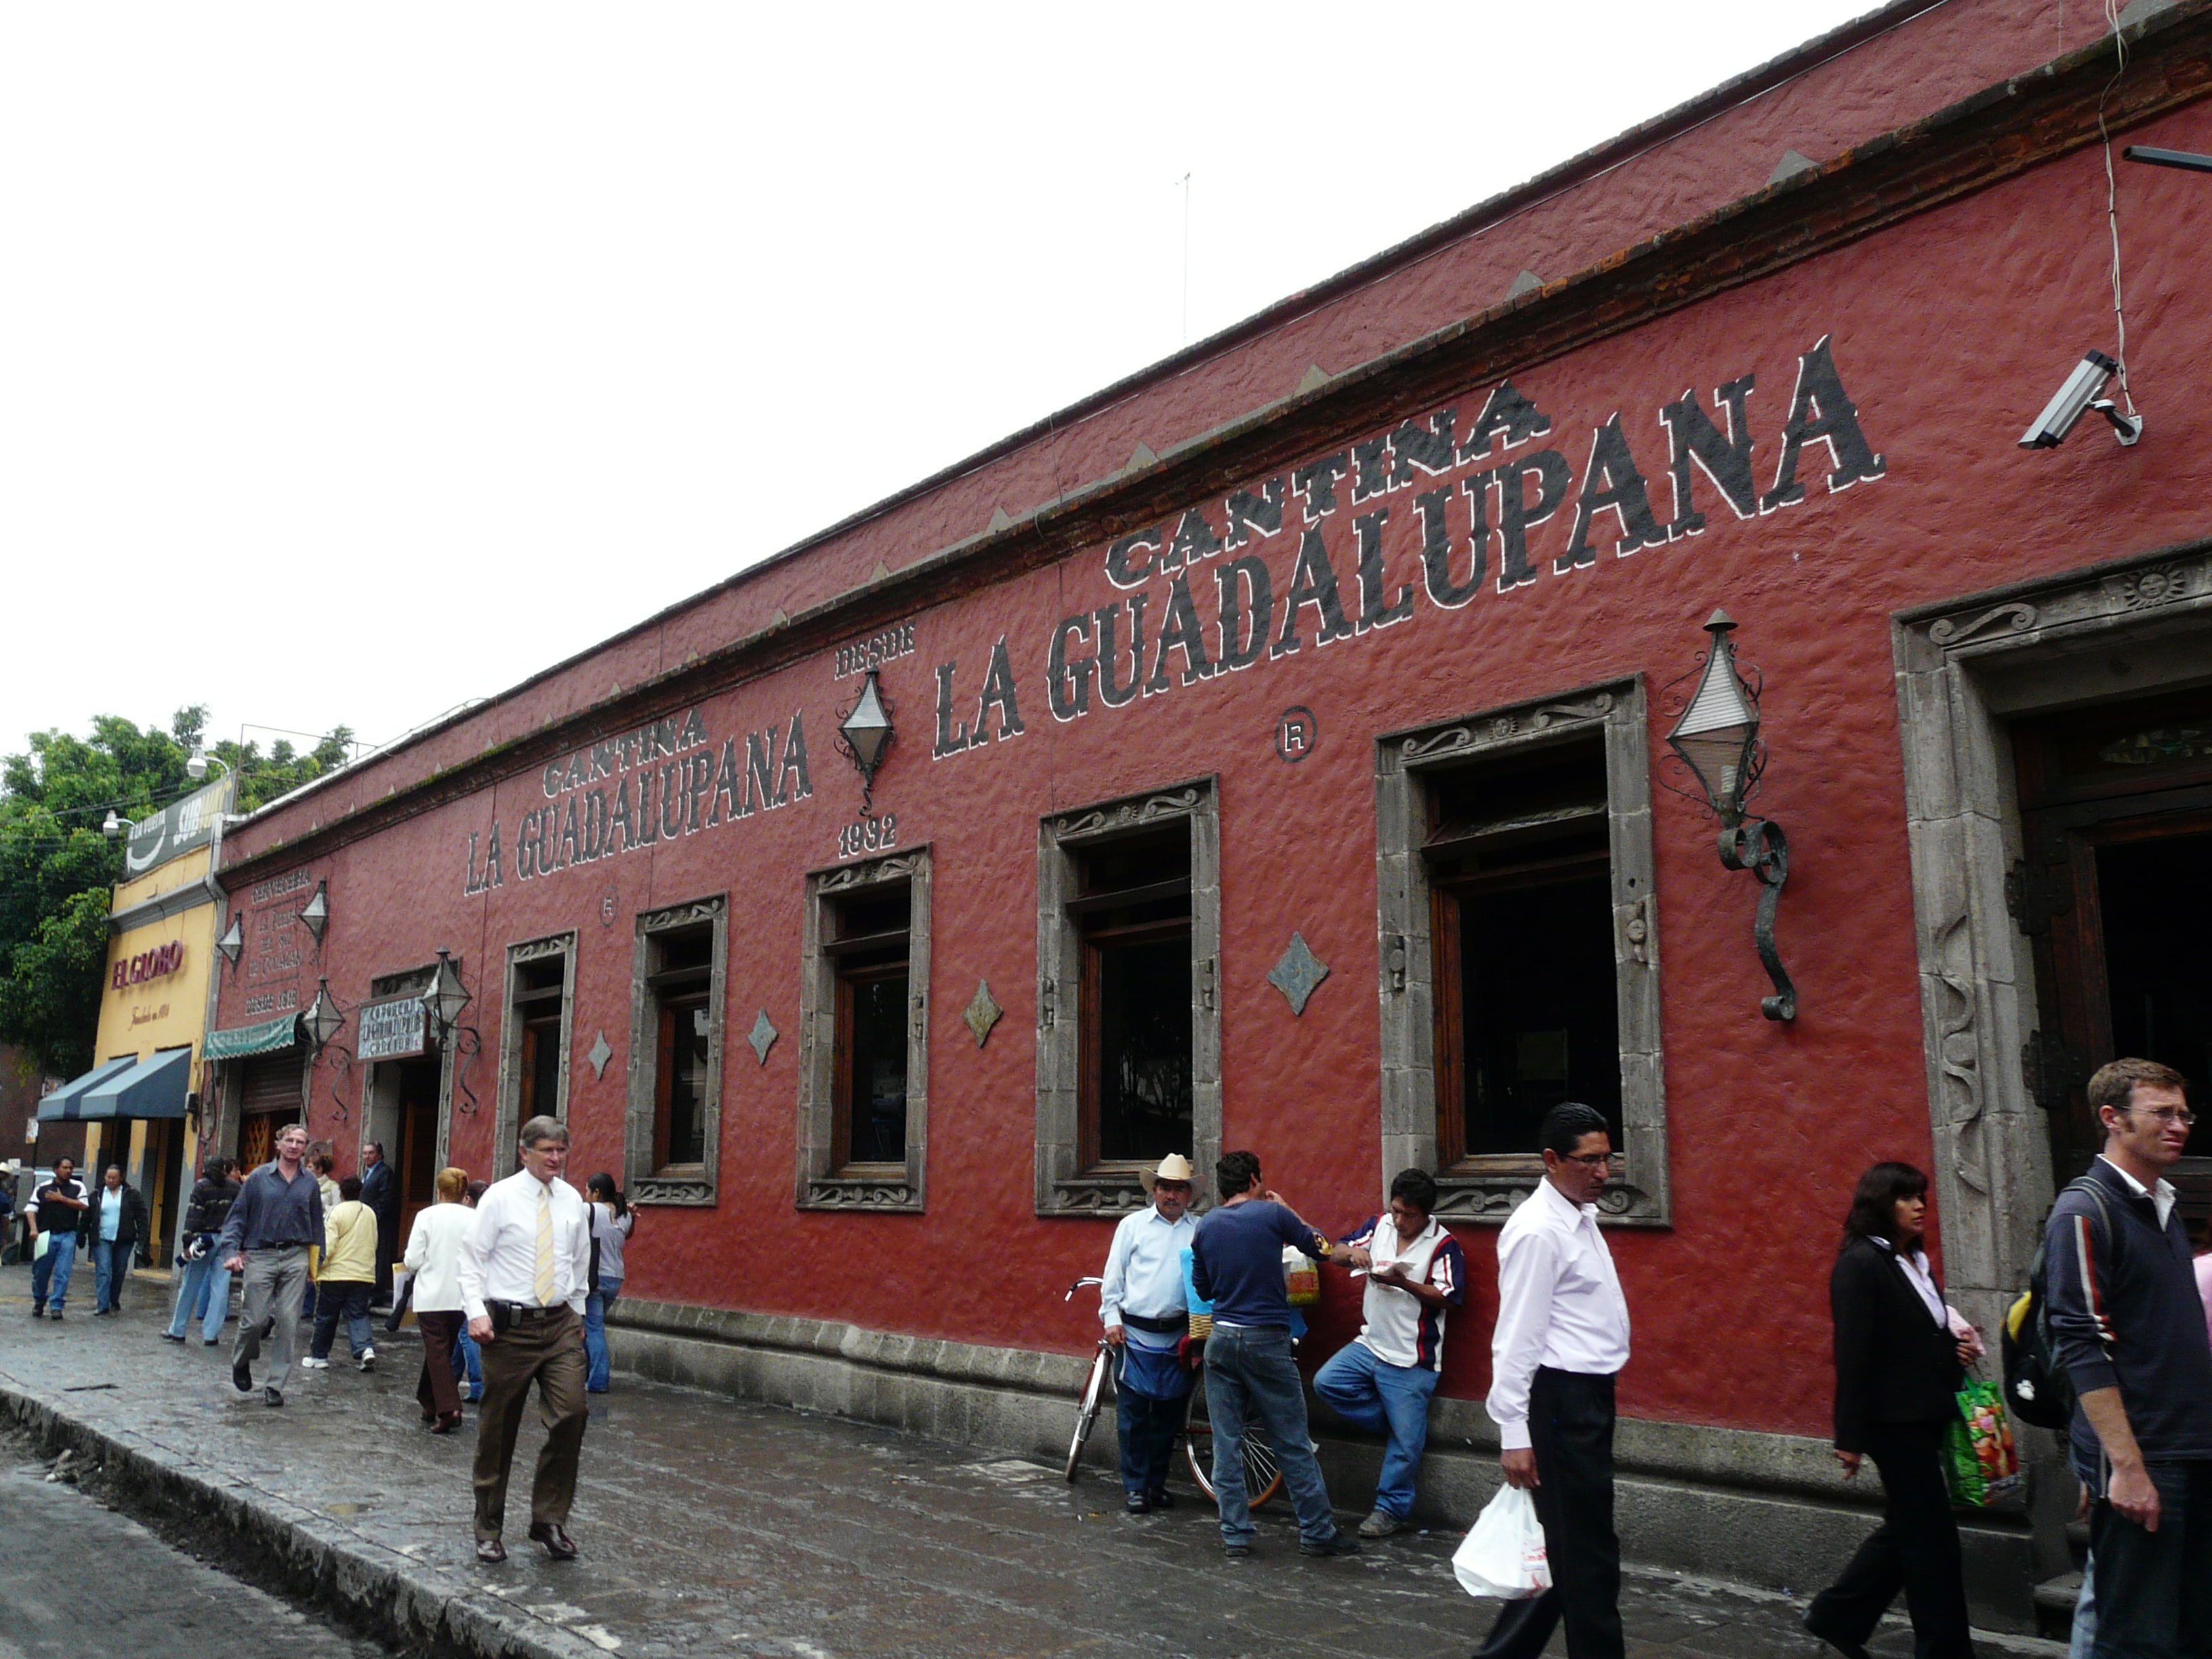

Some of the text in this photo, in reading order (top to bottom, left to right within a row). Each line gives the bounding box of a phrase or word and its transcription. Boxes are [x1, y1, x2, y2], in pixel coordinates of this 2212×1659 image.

[1105, 379, 1551, 591] CANTINA
[933, 332, 1887, 761] LA GUADALUPANA
[834, 621, 916, 680] DESDE
[542, 705, 709, 799] CANTINA
[464, 708, 813, 897] LA GUADALUPANA
[838, 813, 897, 859] 1932
[110, 939, 184, 990] EL GLOBO
[245, 993, 274, 1017] DESDE
